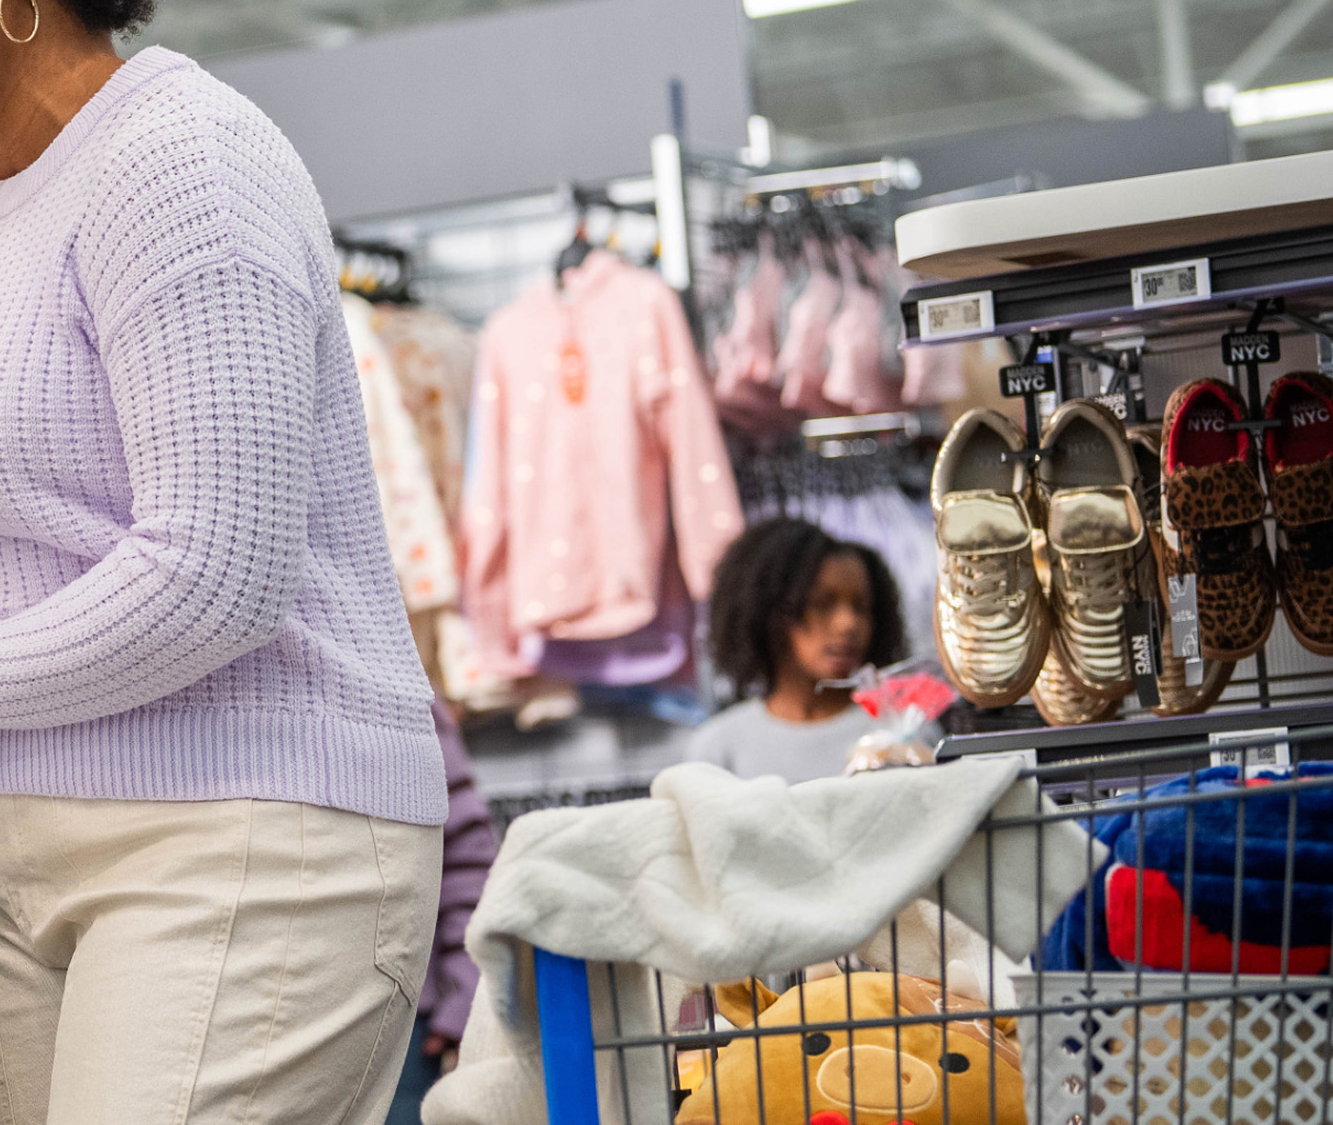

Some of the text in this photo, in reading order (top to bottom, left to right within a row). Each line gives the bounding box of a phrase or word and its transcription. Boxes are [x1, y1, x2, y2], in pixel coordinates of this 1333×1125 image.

[1230, 335, 1269, 345] MADDEN
[1231, 344, 1270, 361] NYC
[1007, 376, 1046, 394] NYC
[1188, 417, 1225, 433] NYC
[1292, 407, 1331, 427] NYC
[1132, 635, 1147, 675] NYC
